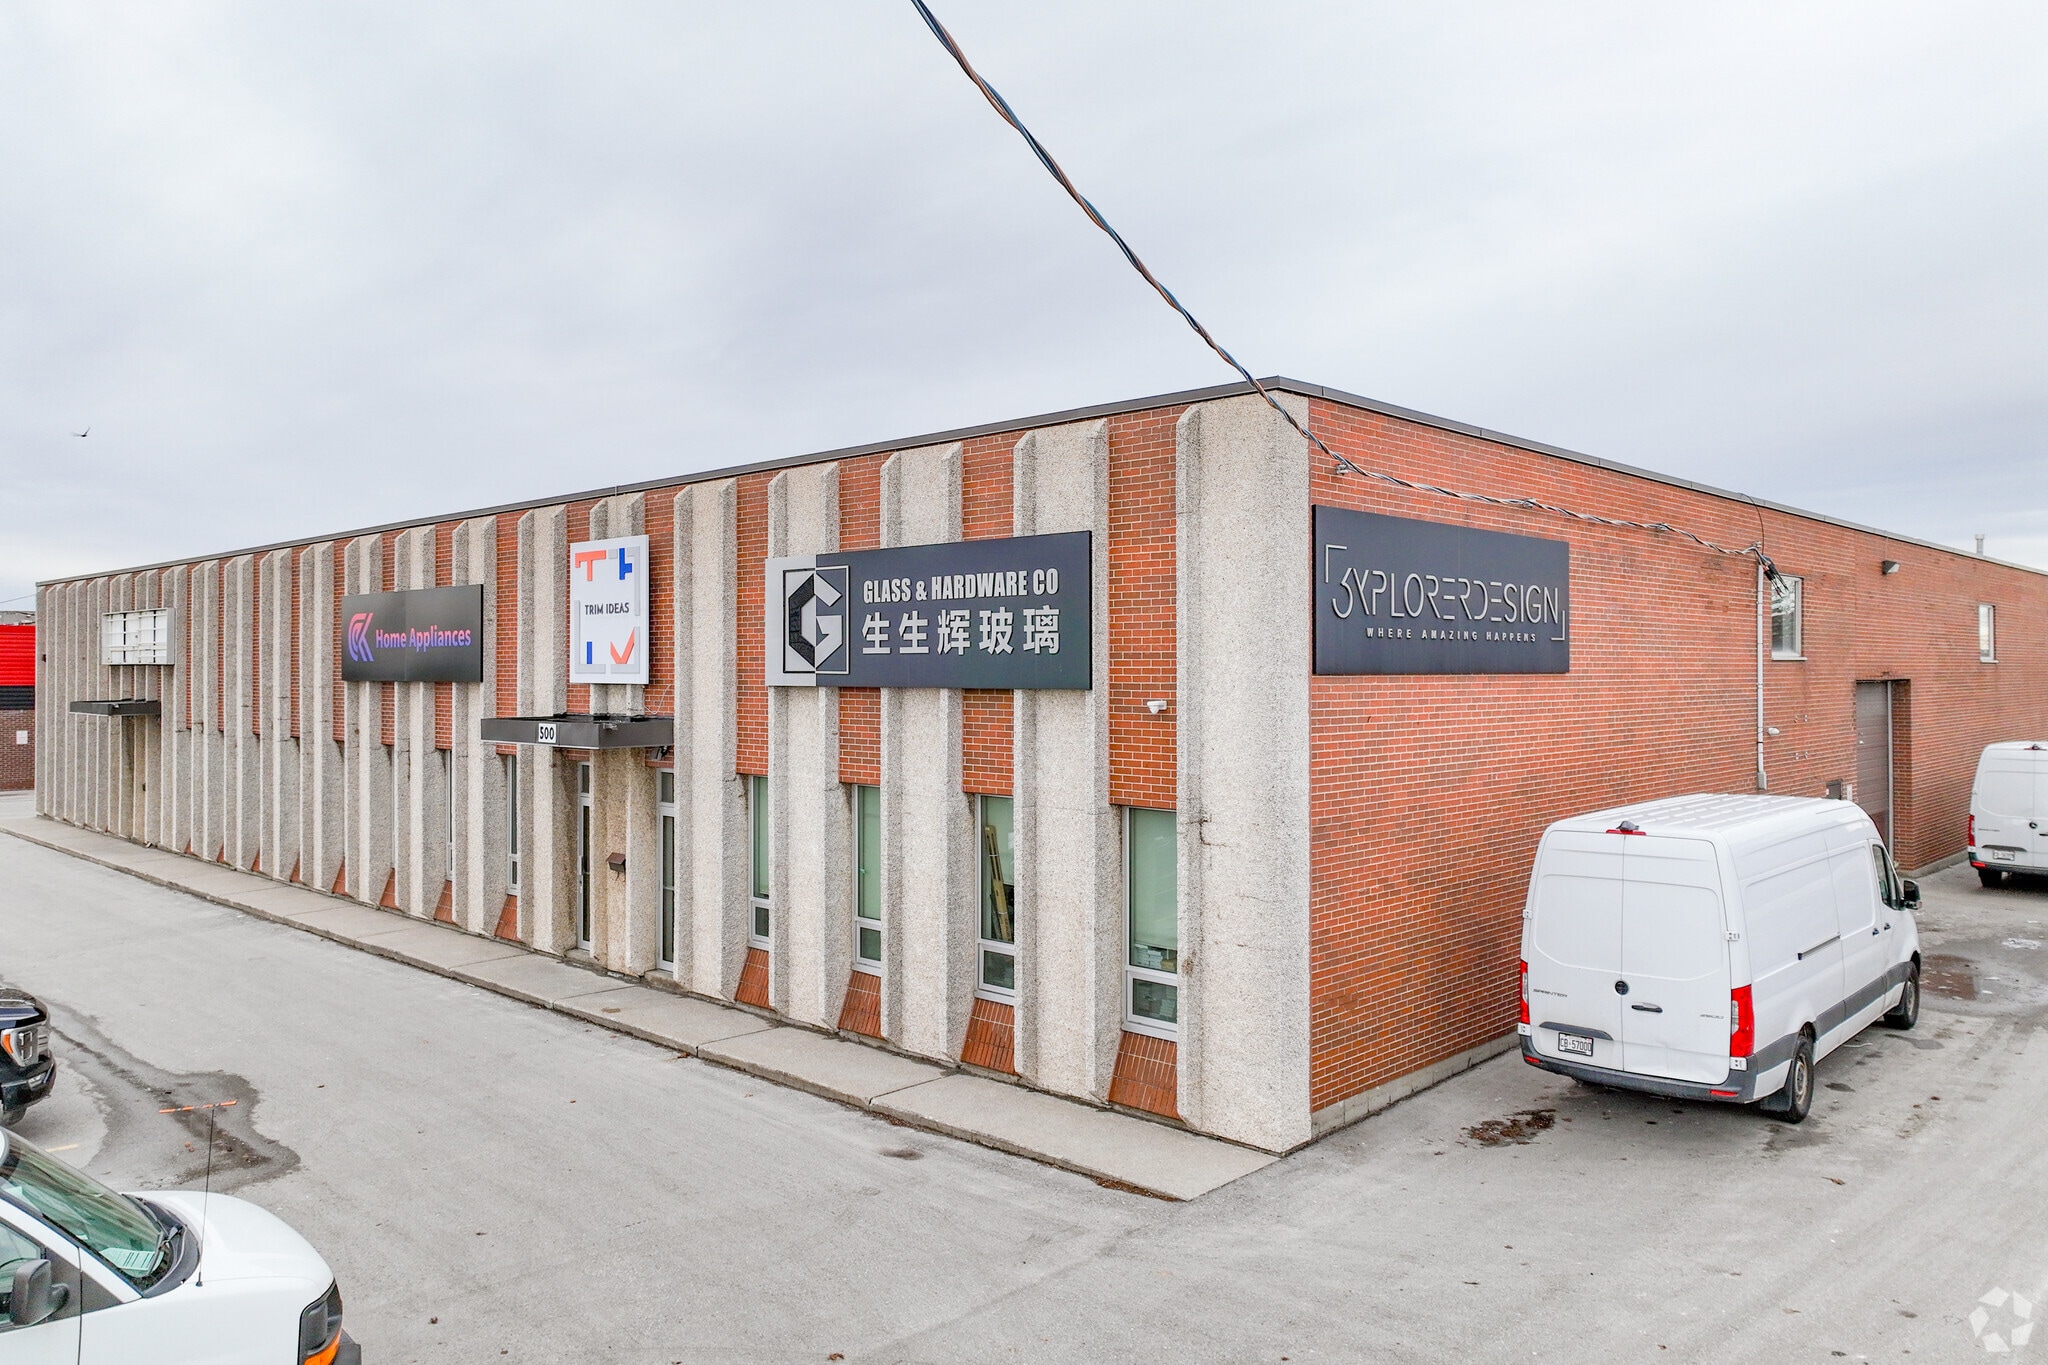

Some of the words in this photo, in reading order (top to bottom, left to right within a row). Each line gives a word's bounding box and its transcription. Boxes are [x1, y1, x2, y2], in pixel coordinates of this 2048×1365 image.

[863, 577, 911, 604] GLASS
[915, 580, 928, 601] &
[931, 570, 1028, 600] HARDWARE
[1032, 568, 1060, 596] CO
[585, 603, 604, 616] TRIM
[606, 602, 630, 614] IDEAS
[375, 629, 407, 648] Home
[409, 624, 472, 653] Appliances
[862, 605, 1061, 656] 生生辉玻璃
[1366, 627, 1412, 639] WHERE
[1421, 629, 1478, 641] AMAZING
[1486, 631, 1537, 642] HAPPENS
[539, 726, 555, 741] 500
